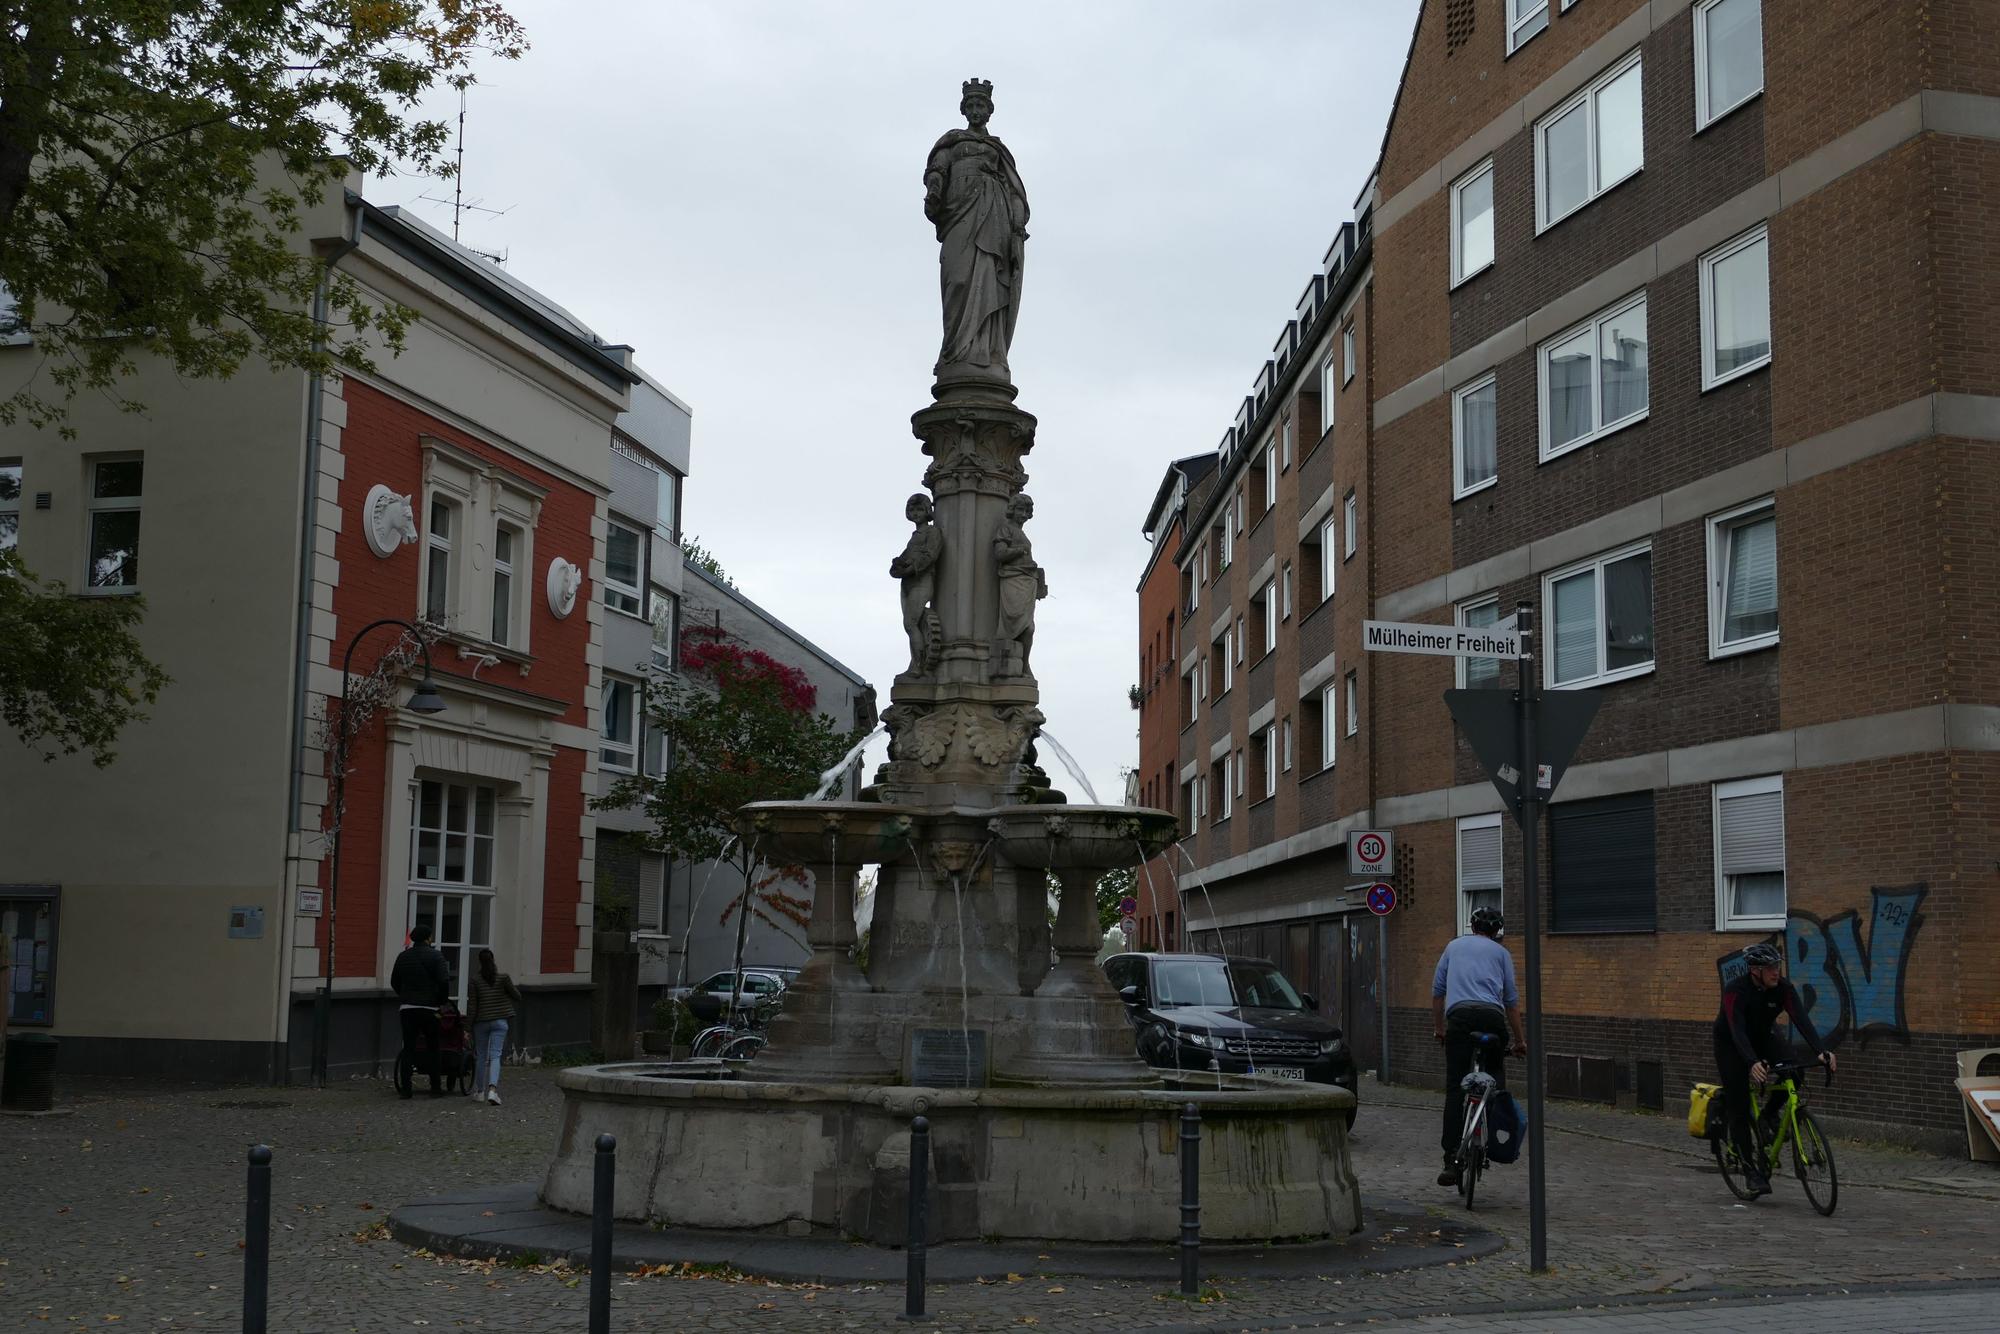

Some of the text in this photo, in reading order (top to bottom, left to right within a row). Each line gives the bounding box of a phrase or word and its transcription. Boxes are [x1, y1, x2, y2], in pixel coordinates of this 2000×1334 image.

[1368, 627, 1516, 655] Mülheimer Freiheit
[1363, 842, 1380, 855] 30
[1361, 864, 1382, 872] ZONE
